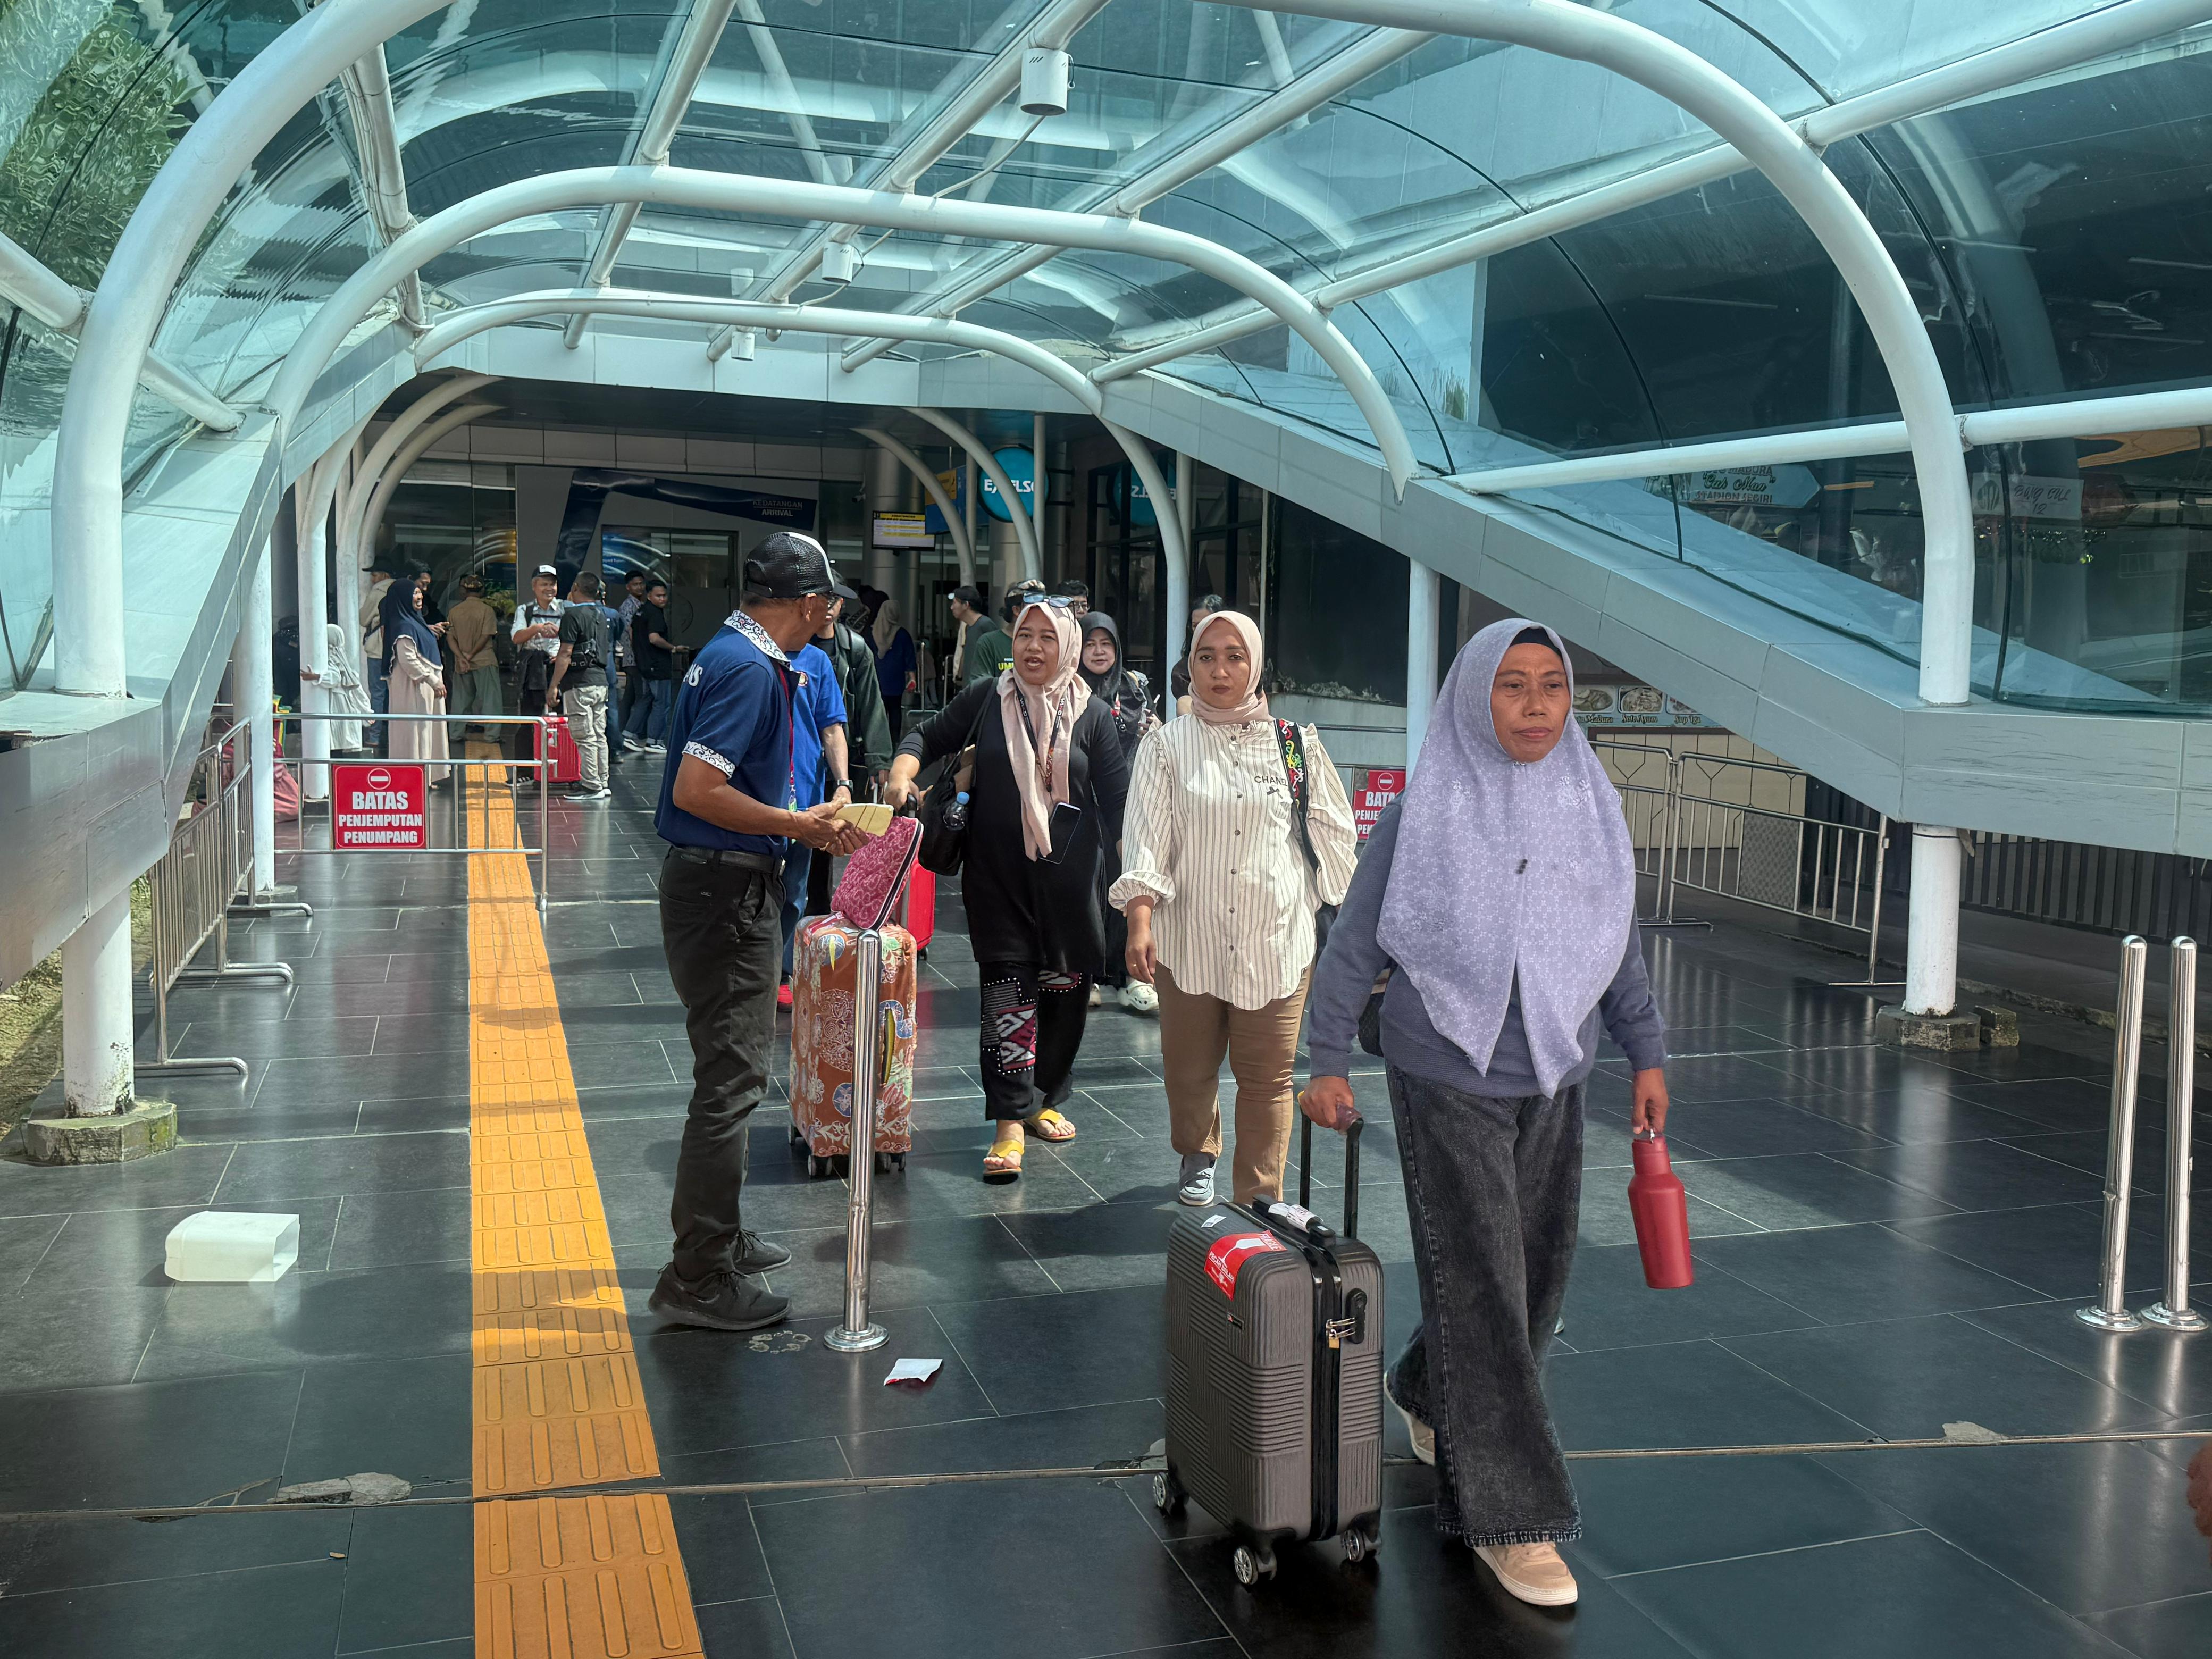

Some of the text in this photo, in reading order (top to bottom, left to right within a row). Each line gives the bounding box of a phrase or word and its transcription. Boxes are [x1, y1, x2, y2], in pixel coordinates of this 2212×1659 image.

[1744, 492, 1773, 504] SEGIRI
[352, 791, 409, 810] BATAS
[1365, 791, 1396, 807] BATA
[338, 814, 423, 827] PENJEMPUTAN
[1355, 810, 1380, 820] PENJE
[343, 831, 418, 844] PENUMPANG
